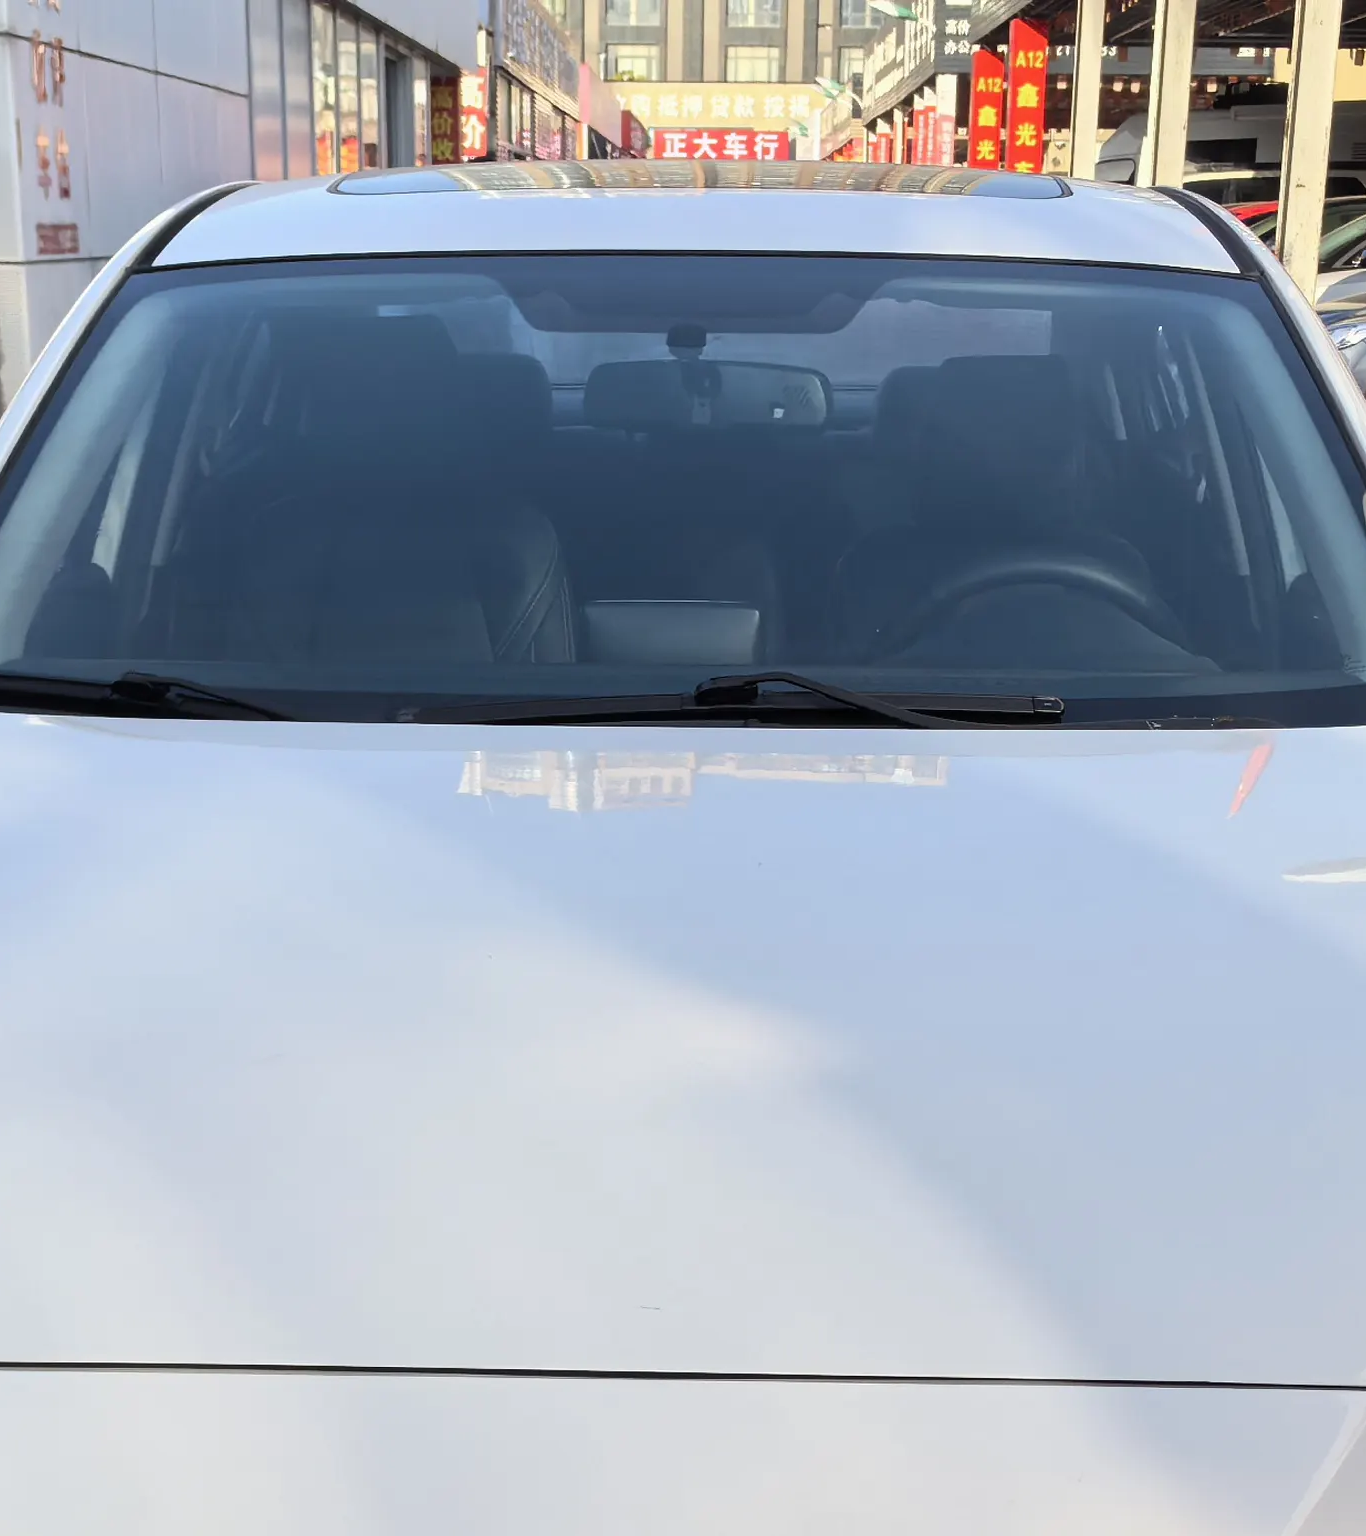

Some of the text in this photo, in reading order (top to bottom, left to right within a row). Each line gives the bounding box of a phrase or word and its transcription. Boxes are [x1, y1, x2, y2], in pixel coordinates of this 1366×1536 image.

[944, 19, 971, 35] 高价
[1015, 51, 1044, 68] A12
[977, 77, 1002, 92] A12
[976, 105, 997, 160] 鑫光
[662, 132, 779, 160] 正大车行
